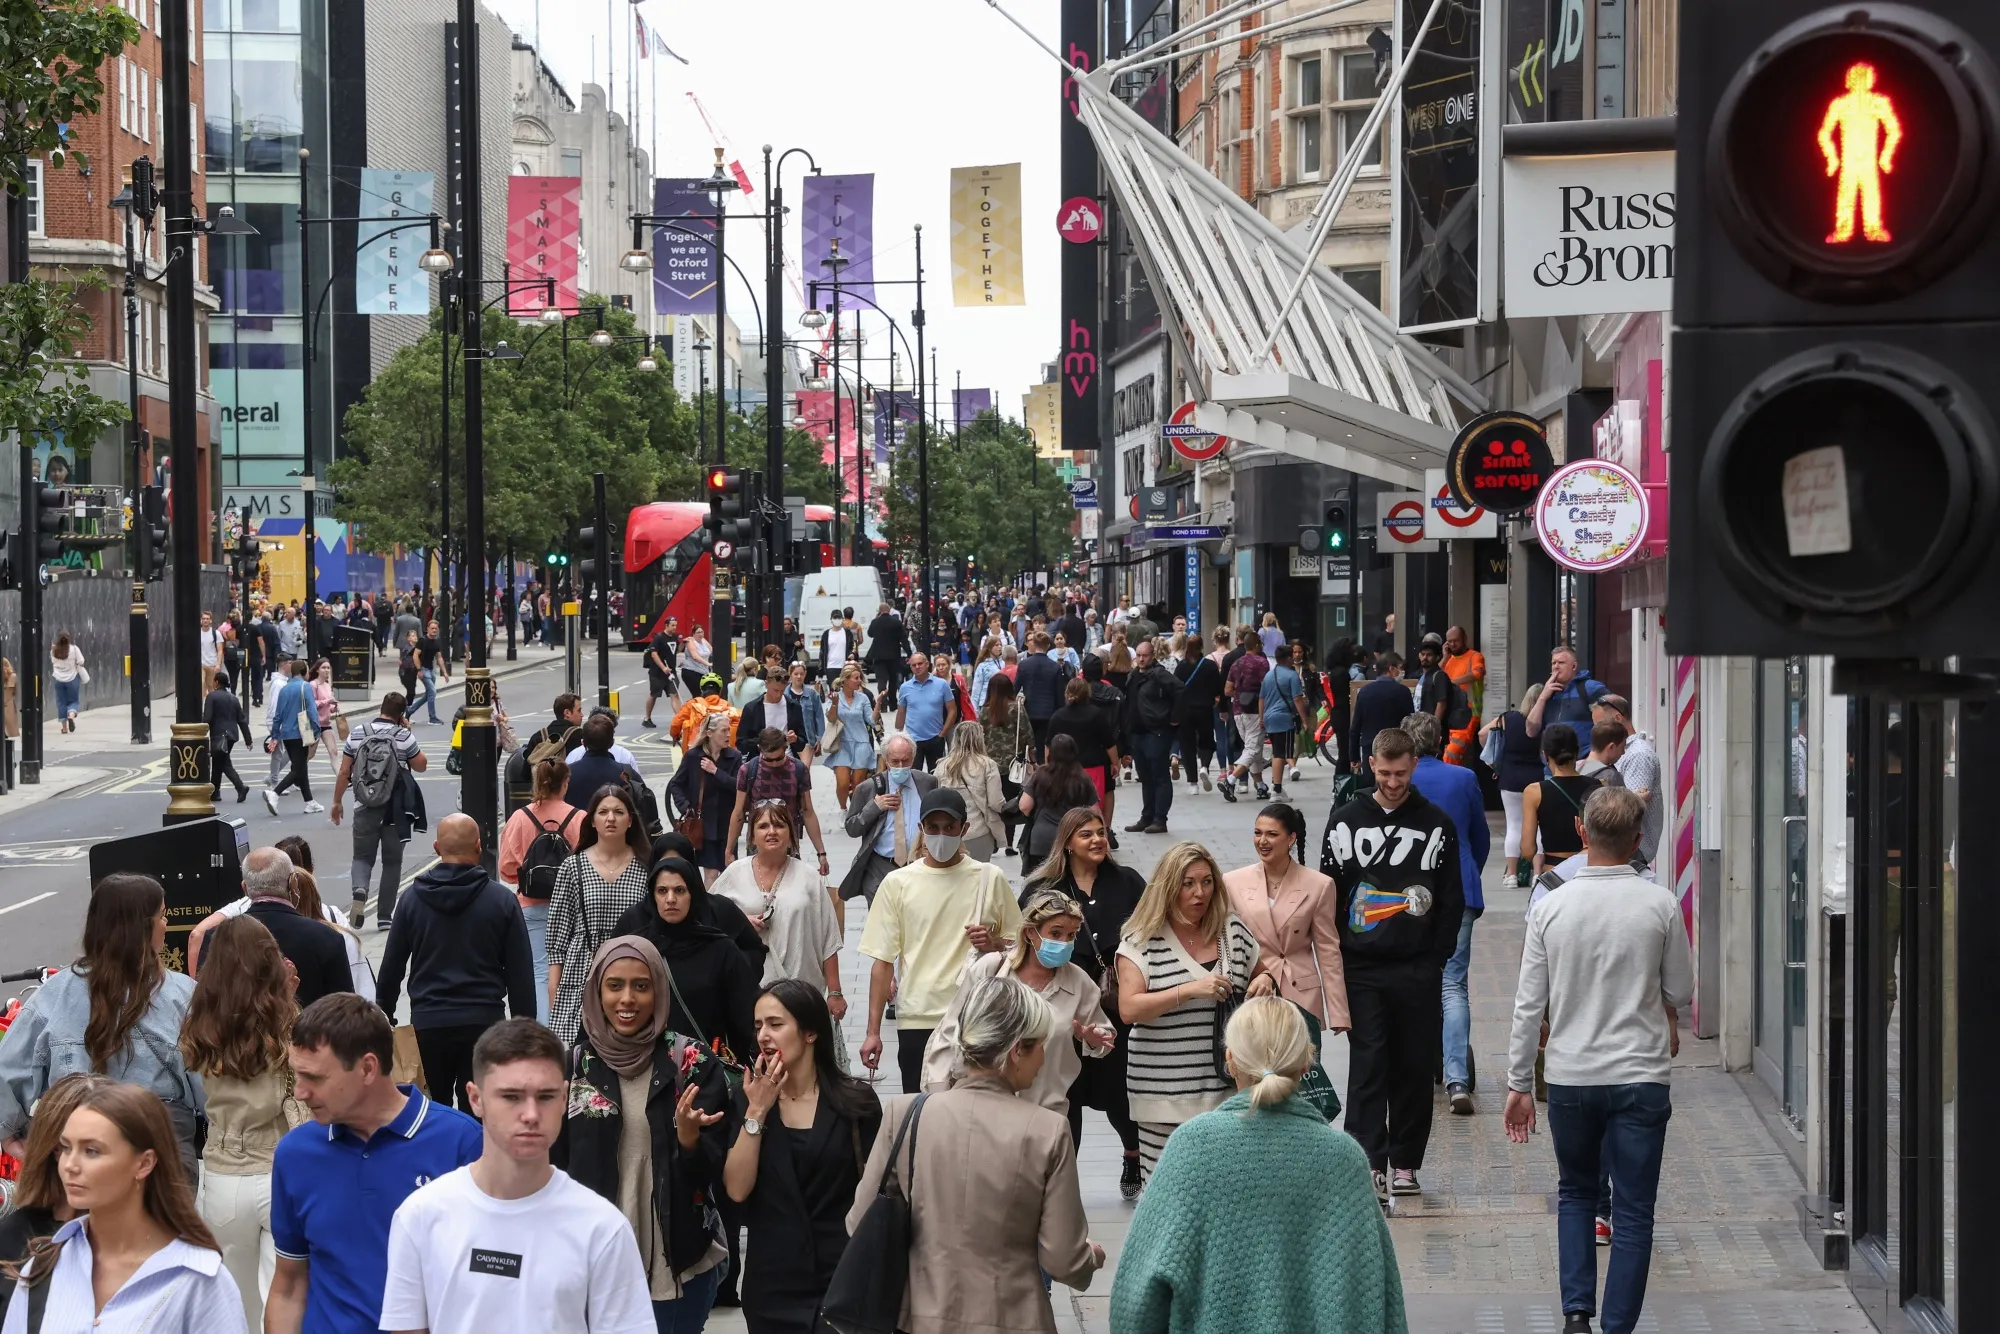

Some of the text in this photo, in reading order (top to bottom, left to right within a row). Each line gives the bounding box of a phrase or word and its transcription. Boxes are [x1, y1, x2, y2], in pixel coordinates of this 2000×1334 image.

[1551, 0, 1584, 69] JD
[1559, 186, 1677, 232] Russ
[386, 191, 402, 311] GREENER
[536, 199, 549, 302] SMARTE
[980, 185, 993, 302] TOGETHER
[669, 258, 708, 267] Oxford
[671, 271, 706, 280] Street
[679, 322, 687, 353] JOHN
[1064, 318, 1096, 398] hmv
[1047, 393, 1056, 455] TOGETHER
[1482, 448, 1531, 469] simit
[1557, 488, 1629, 506] American
[1568, 505, 1617, 525] Candy
[1574, 527, 1613, 547] Shop
[1187, 547, 1197, 597] MONEY
[195, 906, 212, 914] BIN
[476, 1254, 516, 1266] CALVIN KLEIN
